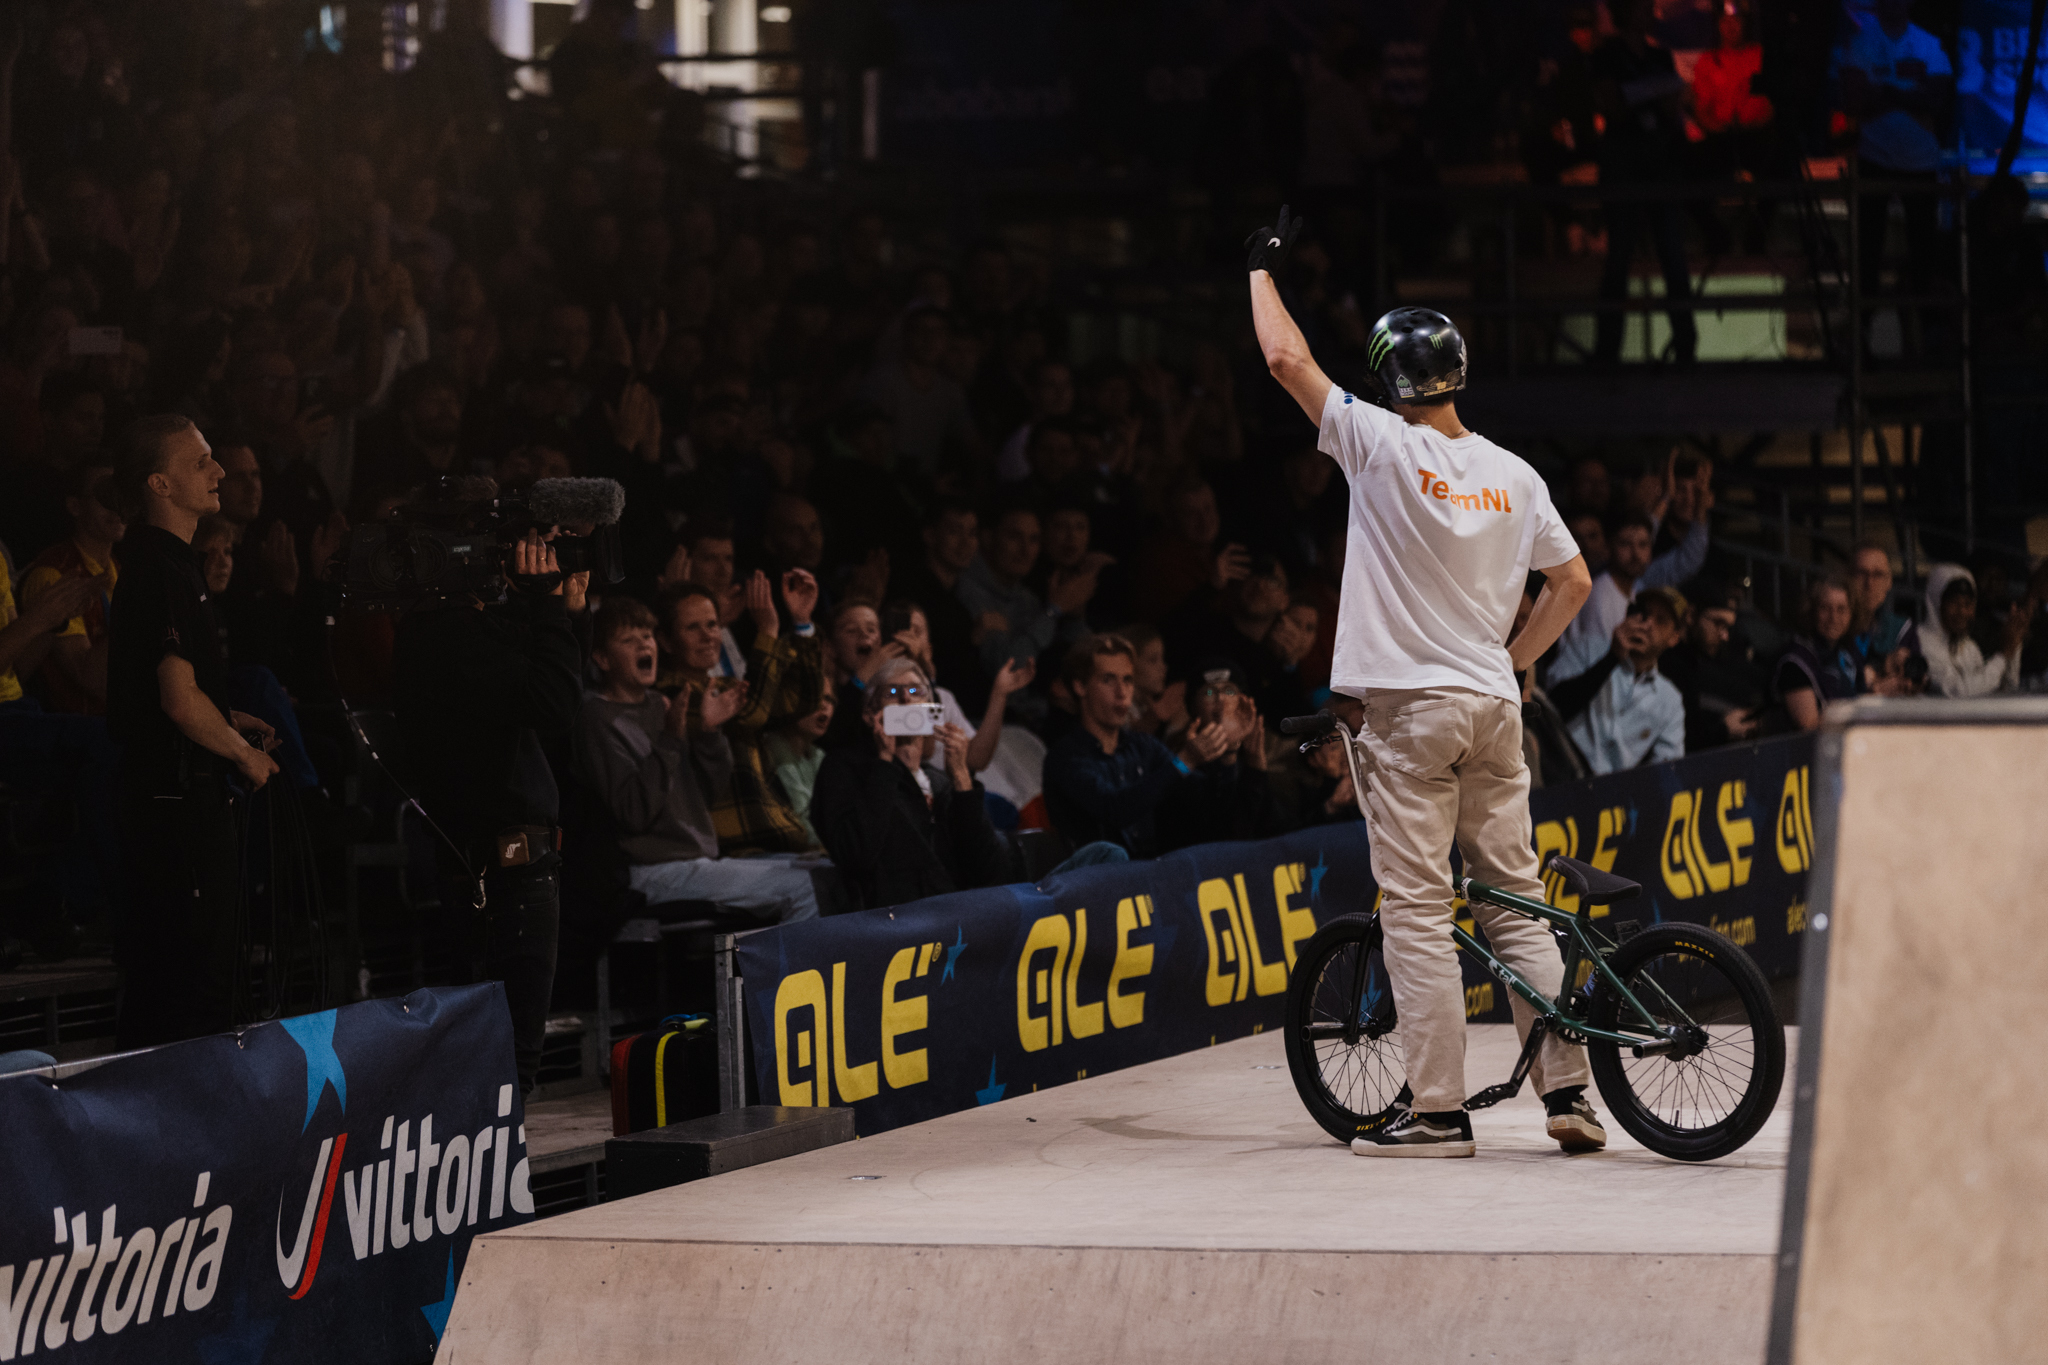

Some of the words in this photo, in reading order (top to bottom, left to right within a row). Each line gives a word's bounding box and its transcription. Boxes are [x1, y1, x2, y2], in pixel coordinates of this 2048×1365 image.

[1674, 940, 1715, 958] MAXXIS
[343, 1084, 535, 1261] vittoria
[0, 1171, 233, 1363] vittoria
